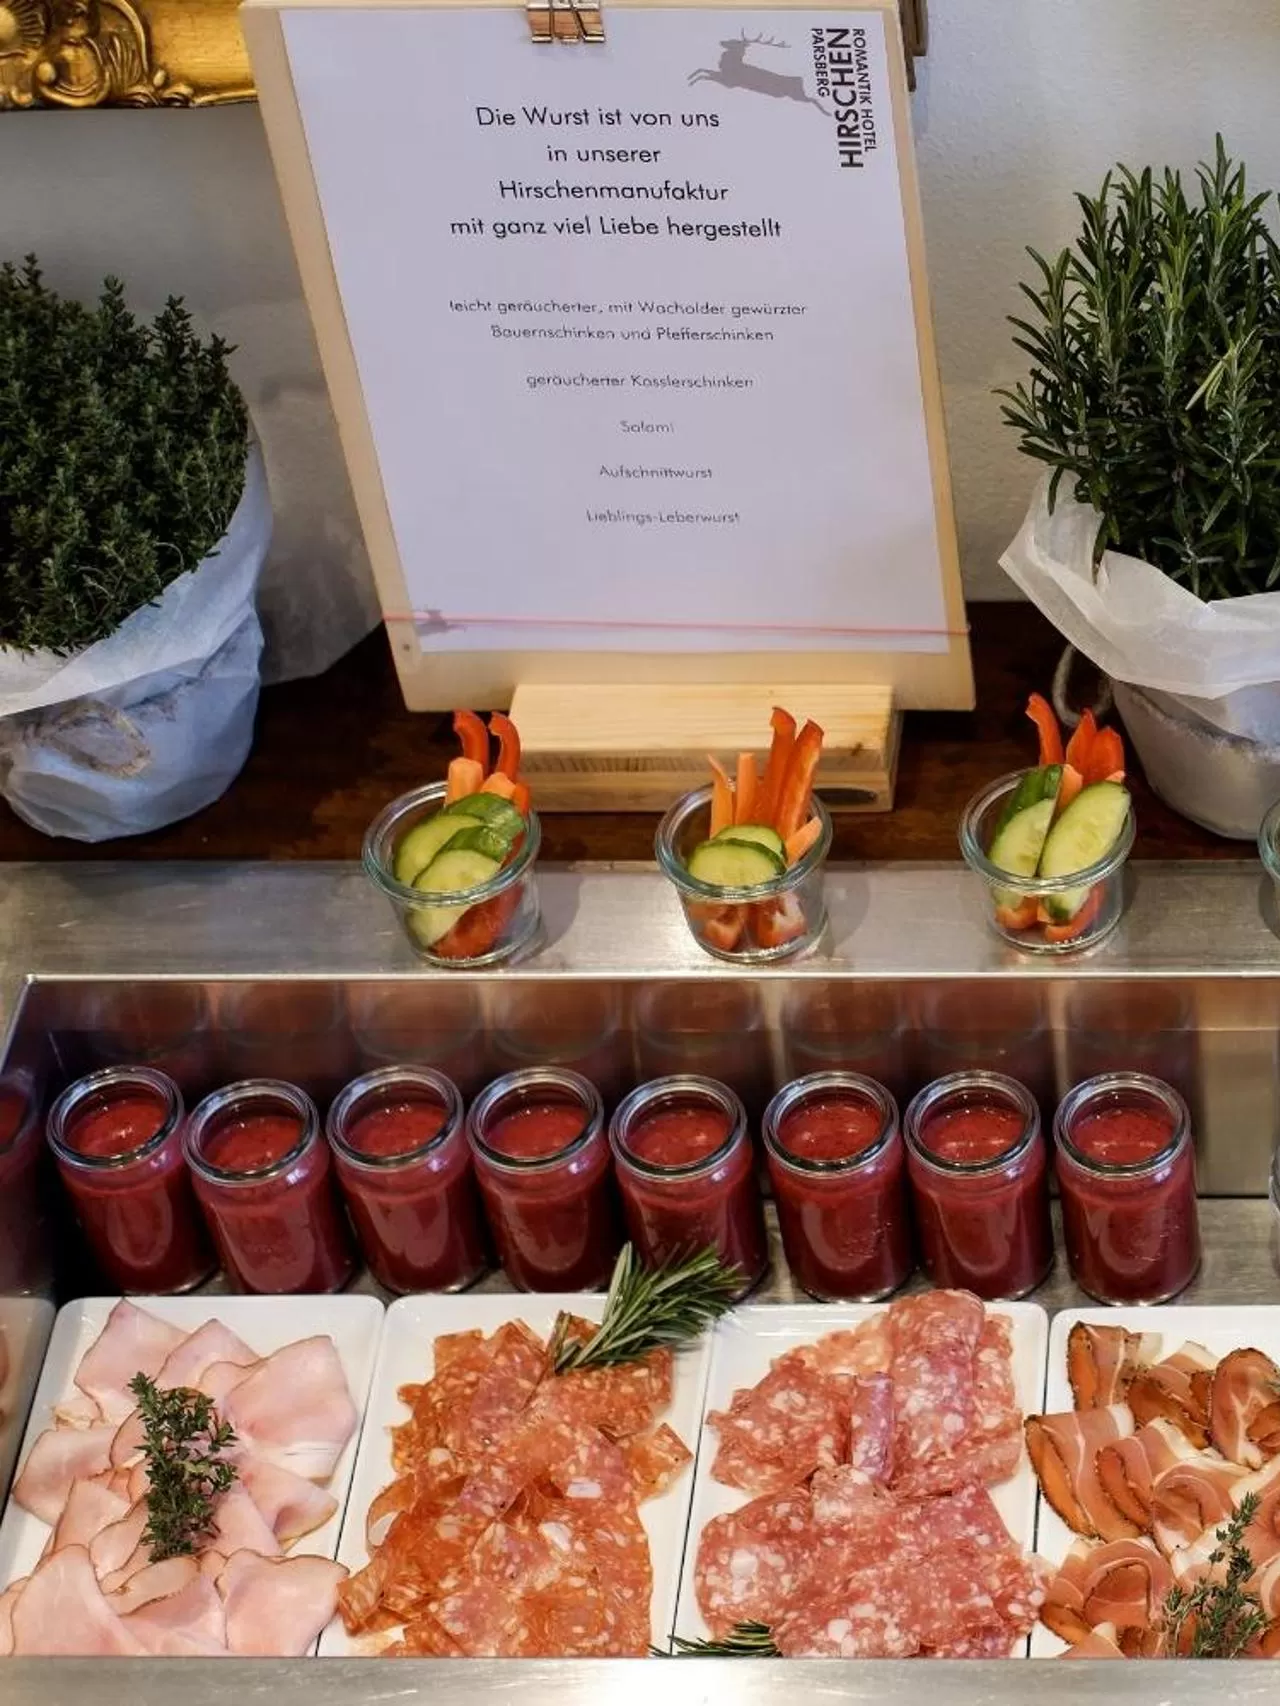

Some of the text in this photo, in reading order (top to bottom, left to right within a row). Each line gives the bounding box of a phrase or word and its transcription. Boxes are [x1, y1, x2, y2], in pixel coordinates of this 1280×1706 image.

[811, 28, 830, 97] PARSBERG
[826, 28, 864, 168] HIRSCHEN
[852, 28, 877, 152] ROMANTIK HOTEL
[475, 105, 721, 129] Die Wurst ist von uns
[545, 144, 662, 165] in unserer
[497, 179, 731, 201] Hirschenmanufaktur
[449, 215, 783, 242] mit ganz viel Liebe hergestellt
[449, 299, 492, 314] leicht
[608, 302, 634, 316] mit
[638, 301, 726, 318] Wacholder
[491, 323, 775, 344] Bauernschinken und Pfefferschinken
[619, 420, 675, 434] Salami
[599, 464, 713, 479] Aufschnittwurst
